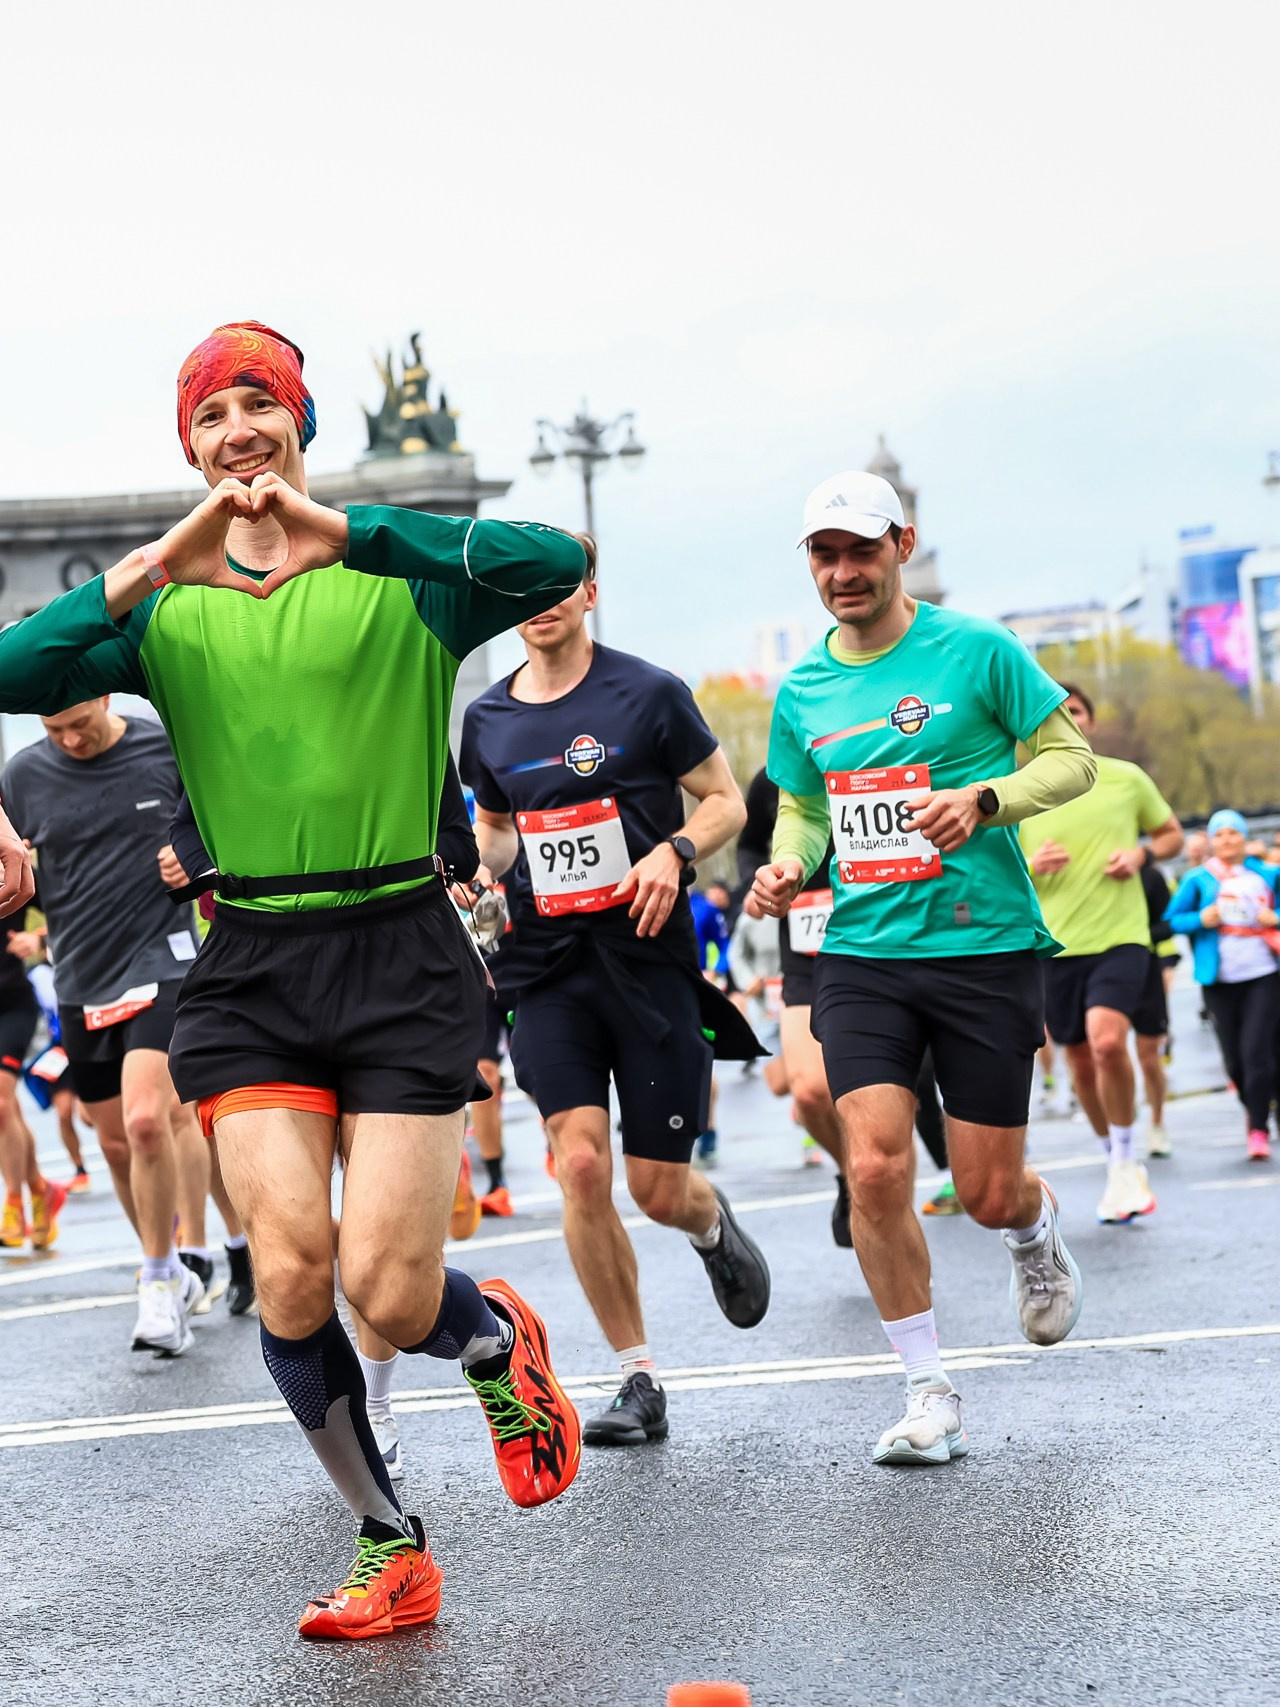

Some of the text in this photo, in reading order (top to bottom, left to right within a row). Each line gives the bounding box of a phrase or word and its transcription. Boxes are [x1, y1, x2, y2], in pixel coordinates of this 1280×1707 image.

[840, 800, 915, 838] 4108
[539, 834, 601, 873] 995
[849, 837, 909, 851] ВЛАДИСЛАВ
[560, 871, 588, 883] ИЛЬЯ
[801, 911, 832, 935] 72
